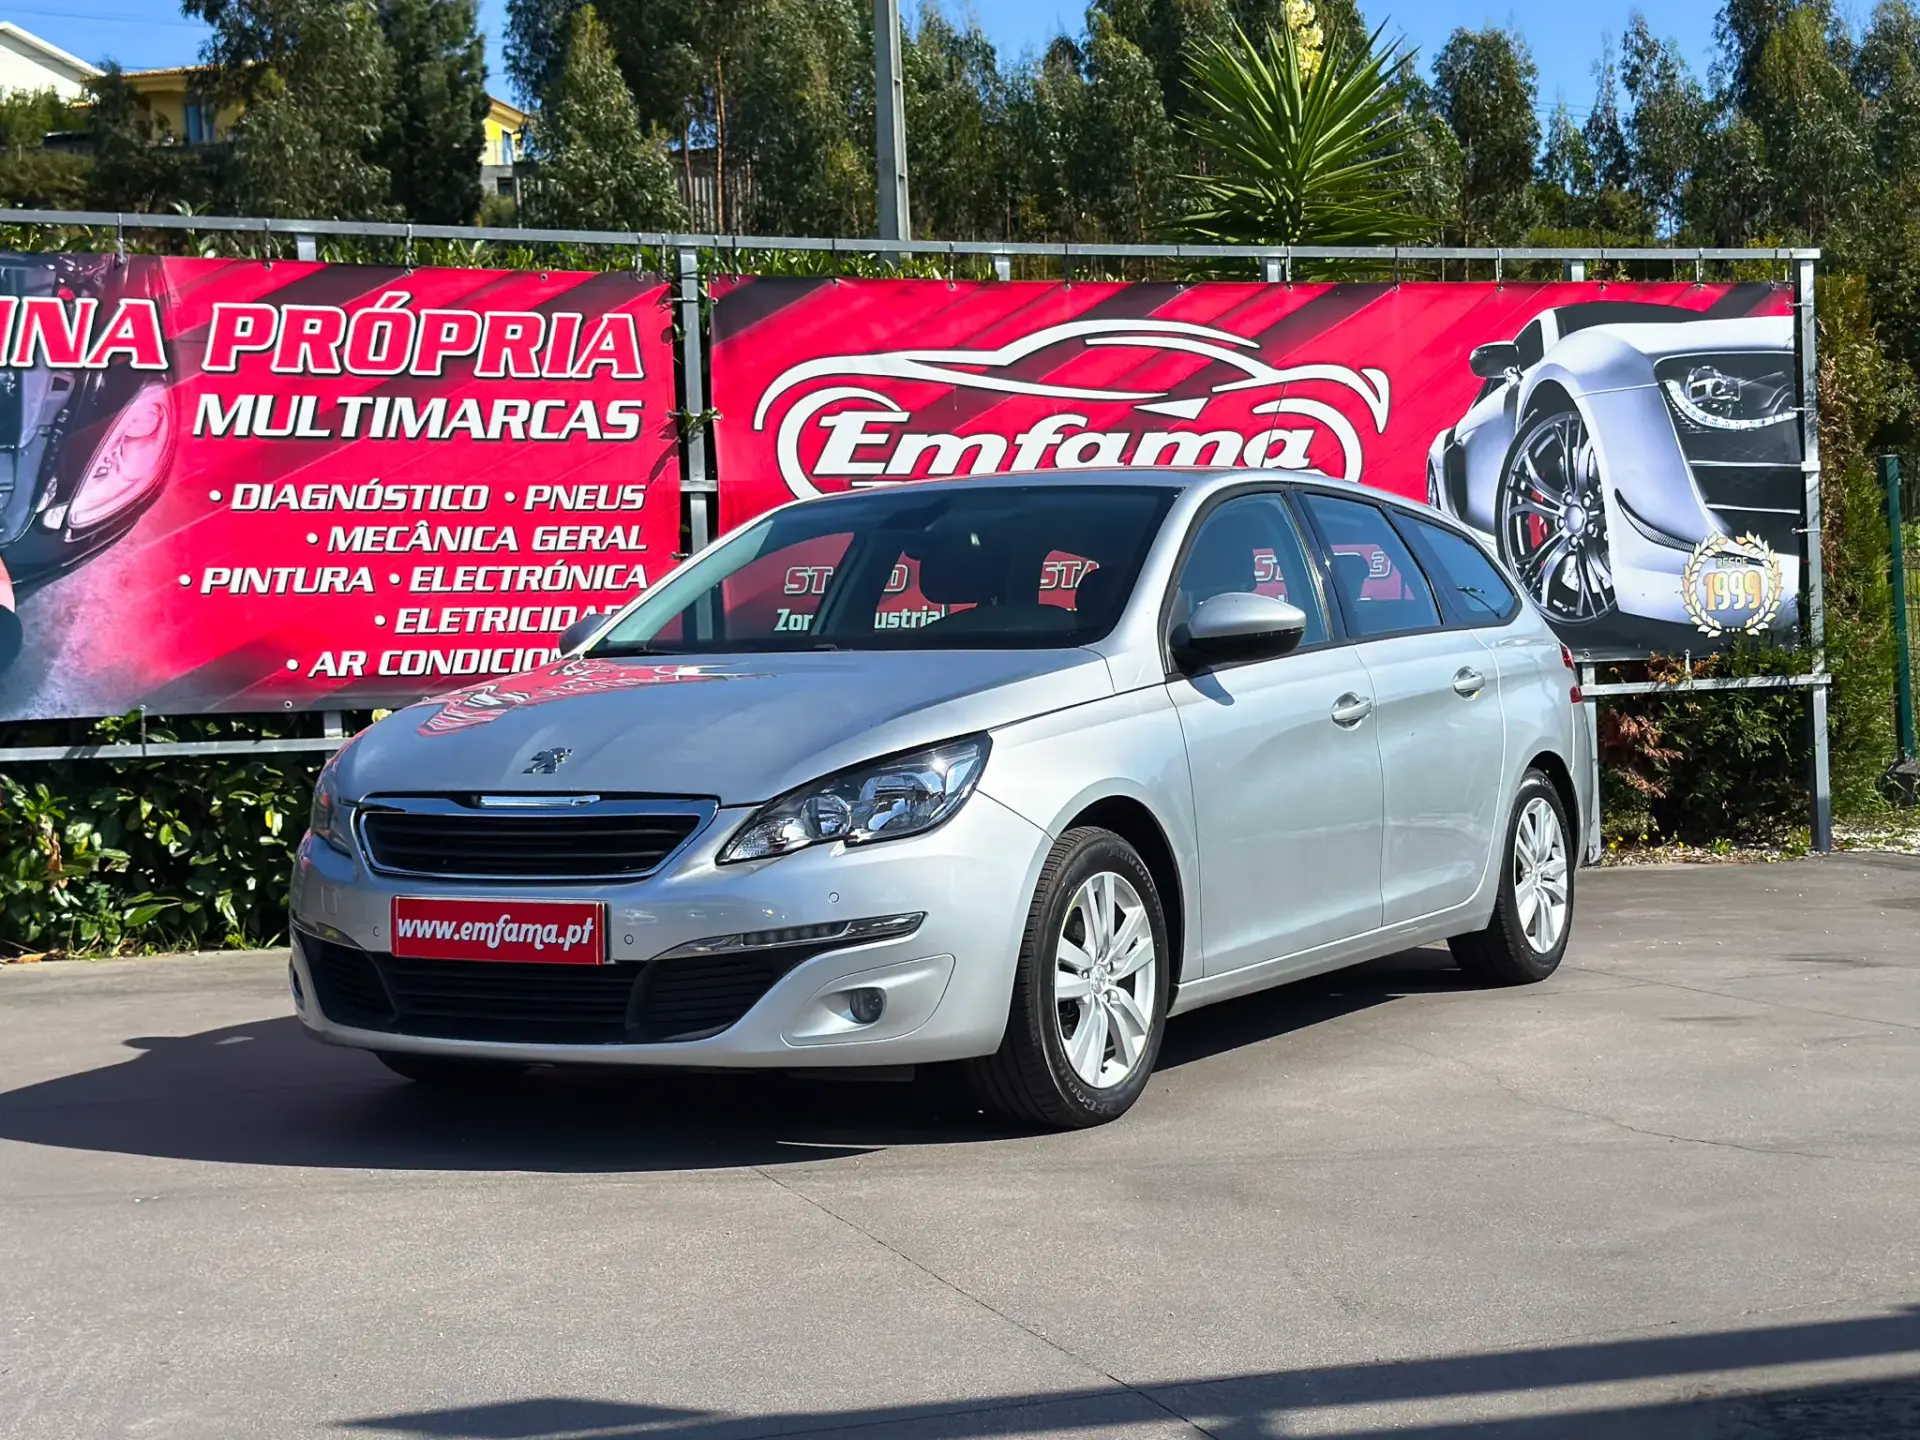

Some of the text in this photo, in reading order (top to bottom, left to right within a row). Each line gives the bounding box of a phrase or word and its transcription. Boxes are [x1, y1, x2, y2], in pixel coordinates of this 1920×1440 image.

[201, 291, 645, 379] PRÓPRIA
[192, 393, 642, 441] MULTIMARCAS
[813, 411, 1311, 475] Emfama
[230, 478, 646, 511] DIAGNÓSTICO PNEUS
[327, 520, 648, 553] MECÂNICA GERAL
[200, 560, 648, 595] PINTURA ELECTRÓNICA
[1703, 570, 1762, 611] 1999
[394, 606, 622, 634] ELETRICID
[307, 650, 368, 678] AR
[397, 913, 594, 952] www.emfama.pt
